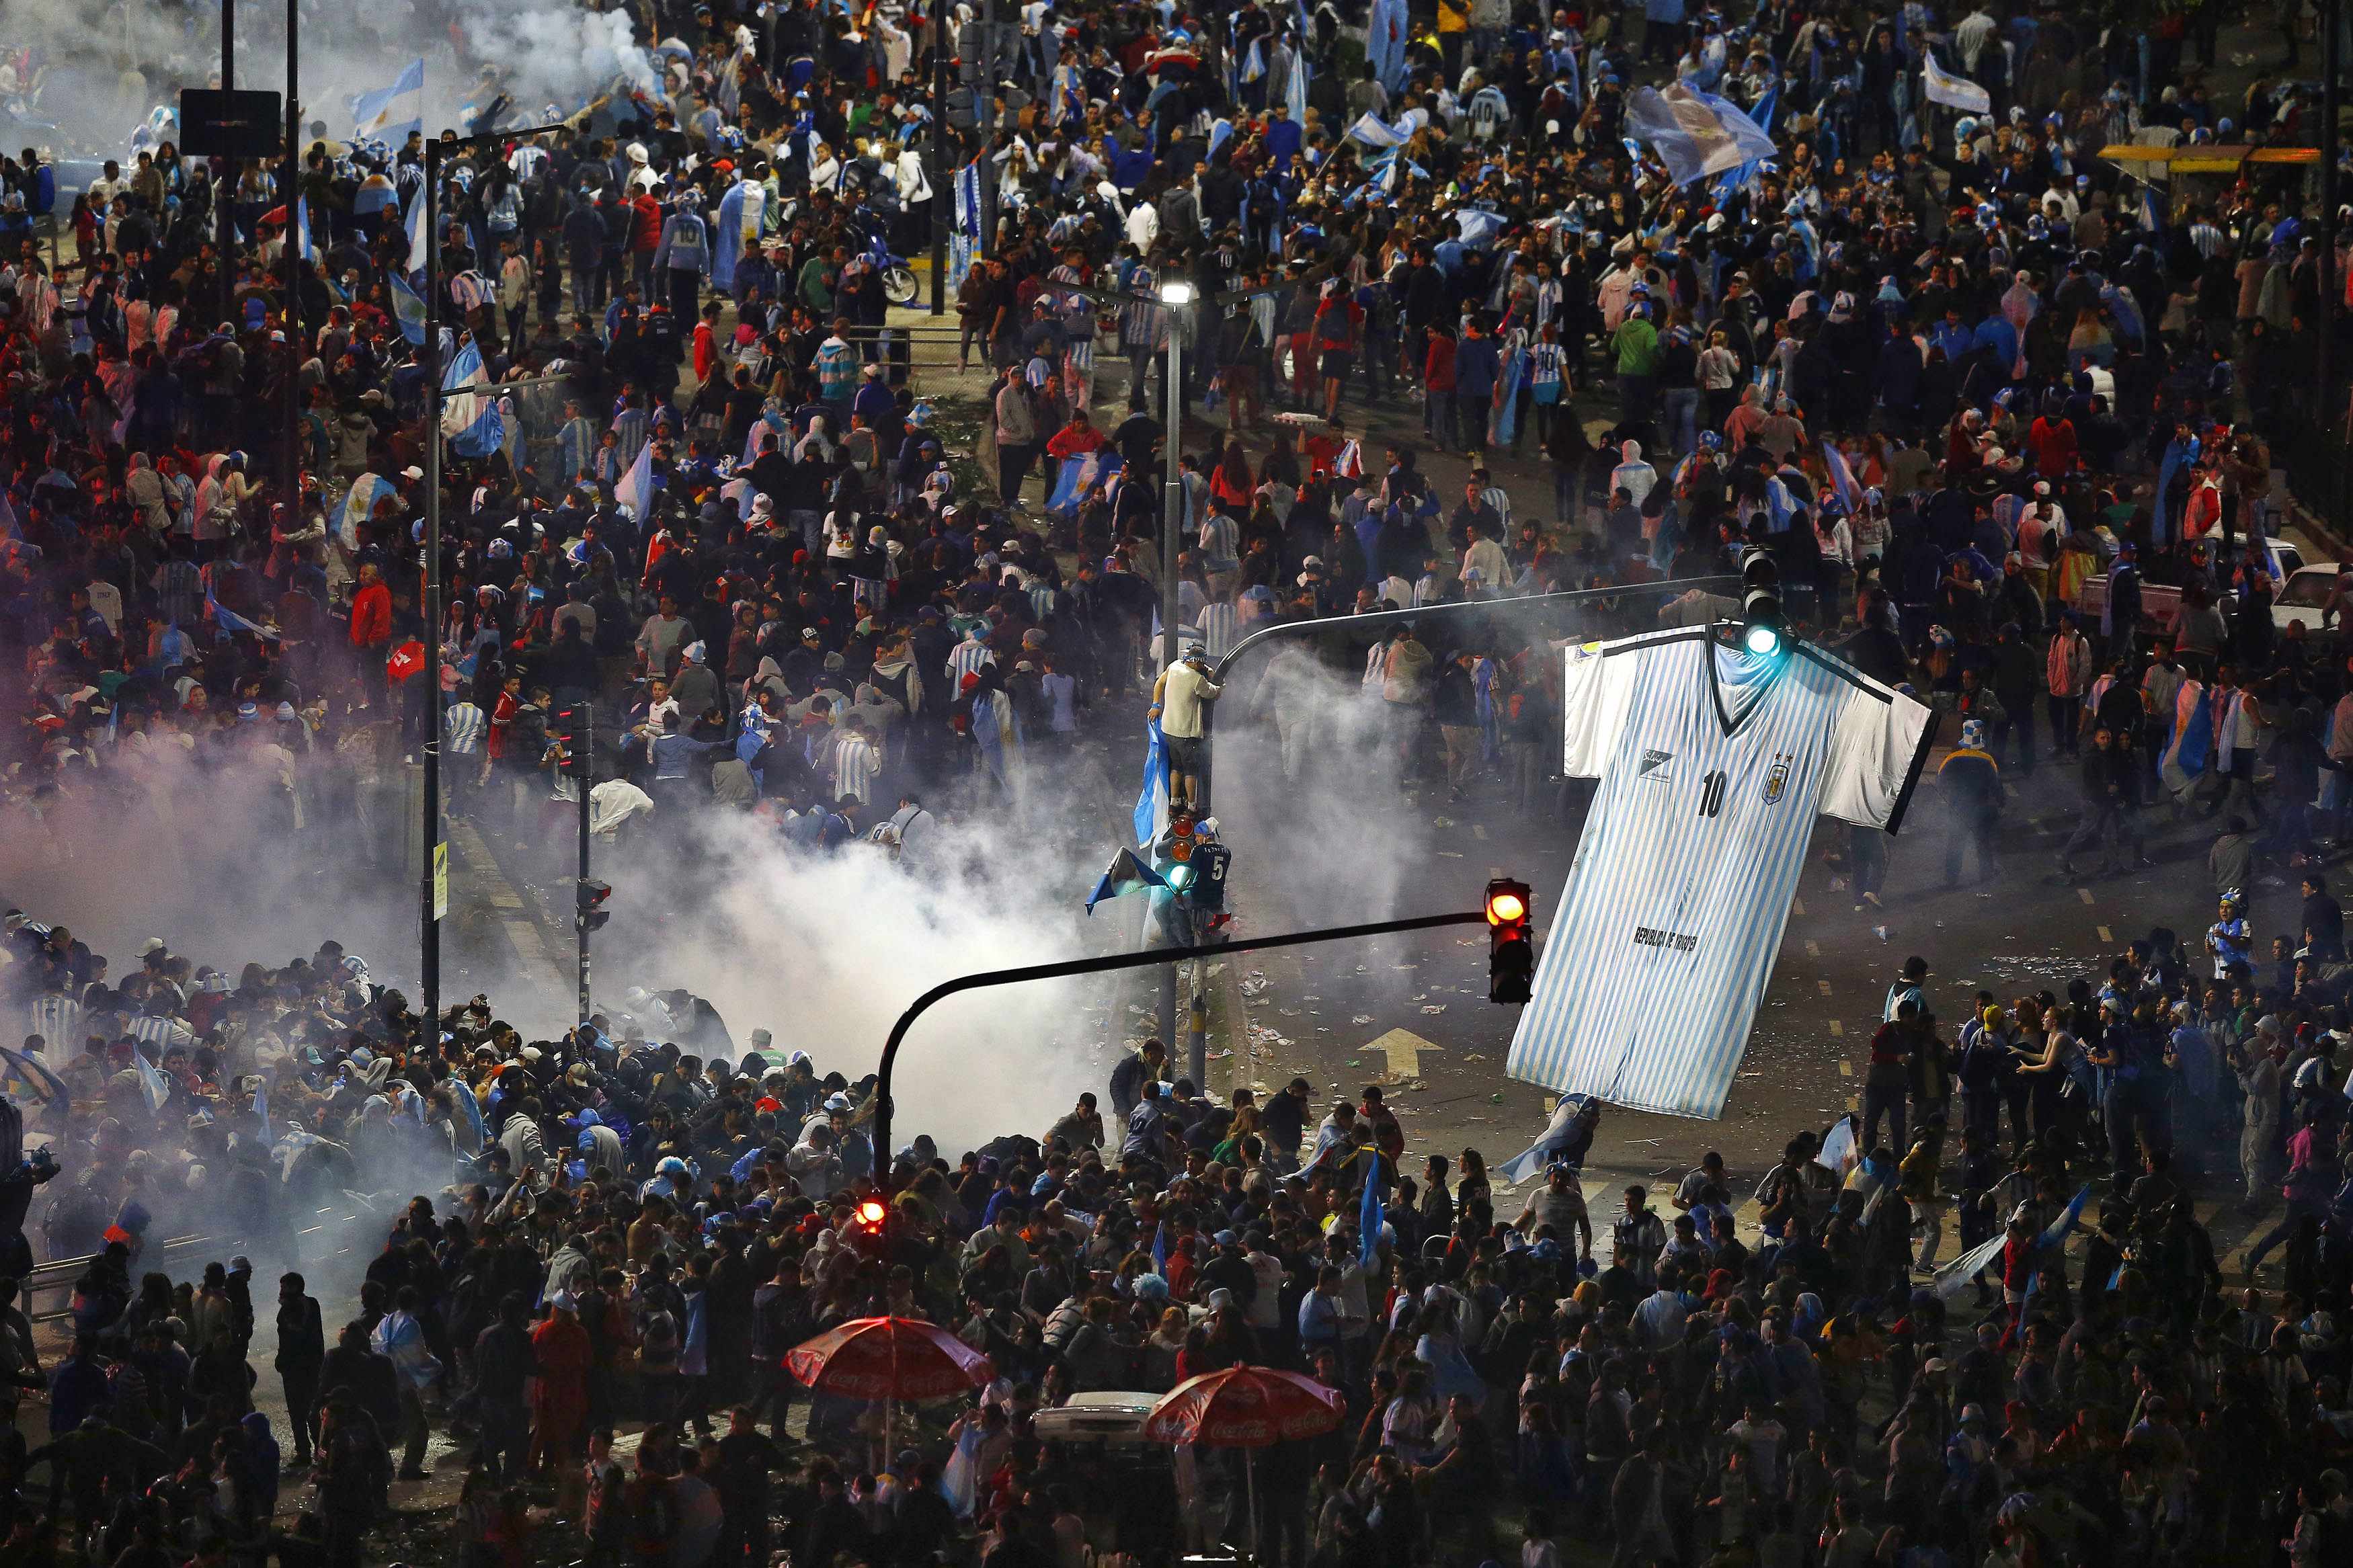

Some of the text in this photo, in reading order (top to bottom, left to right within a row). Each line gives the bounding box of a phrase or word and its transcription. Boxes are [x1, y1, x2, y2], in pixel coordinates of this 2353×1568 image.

[1643, 750, 1663, 764] Silvia
[1698, 770, 1727, 818] 10
[1211, 856, 1224, 880] 5
[1633, 926, 1667, 948] REPUBLICA
[1665, 931, 1676, 948] DE
